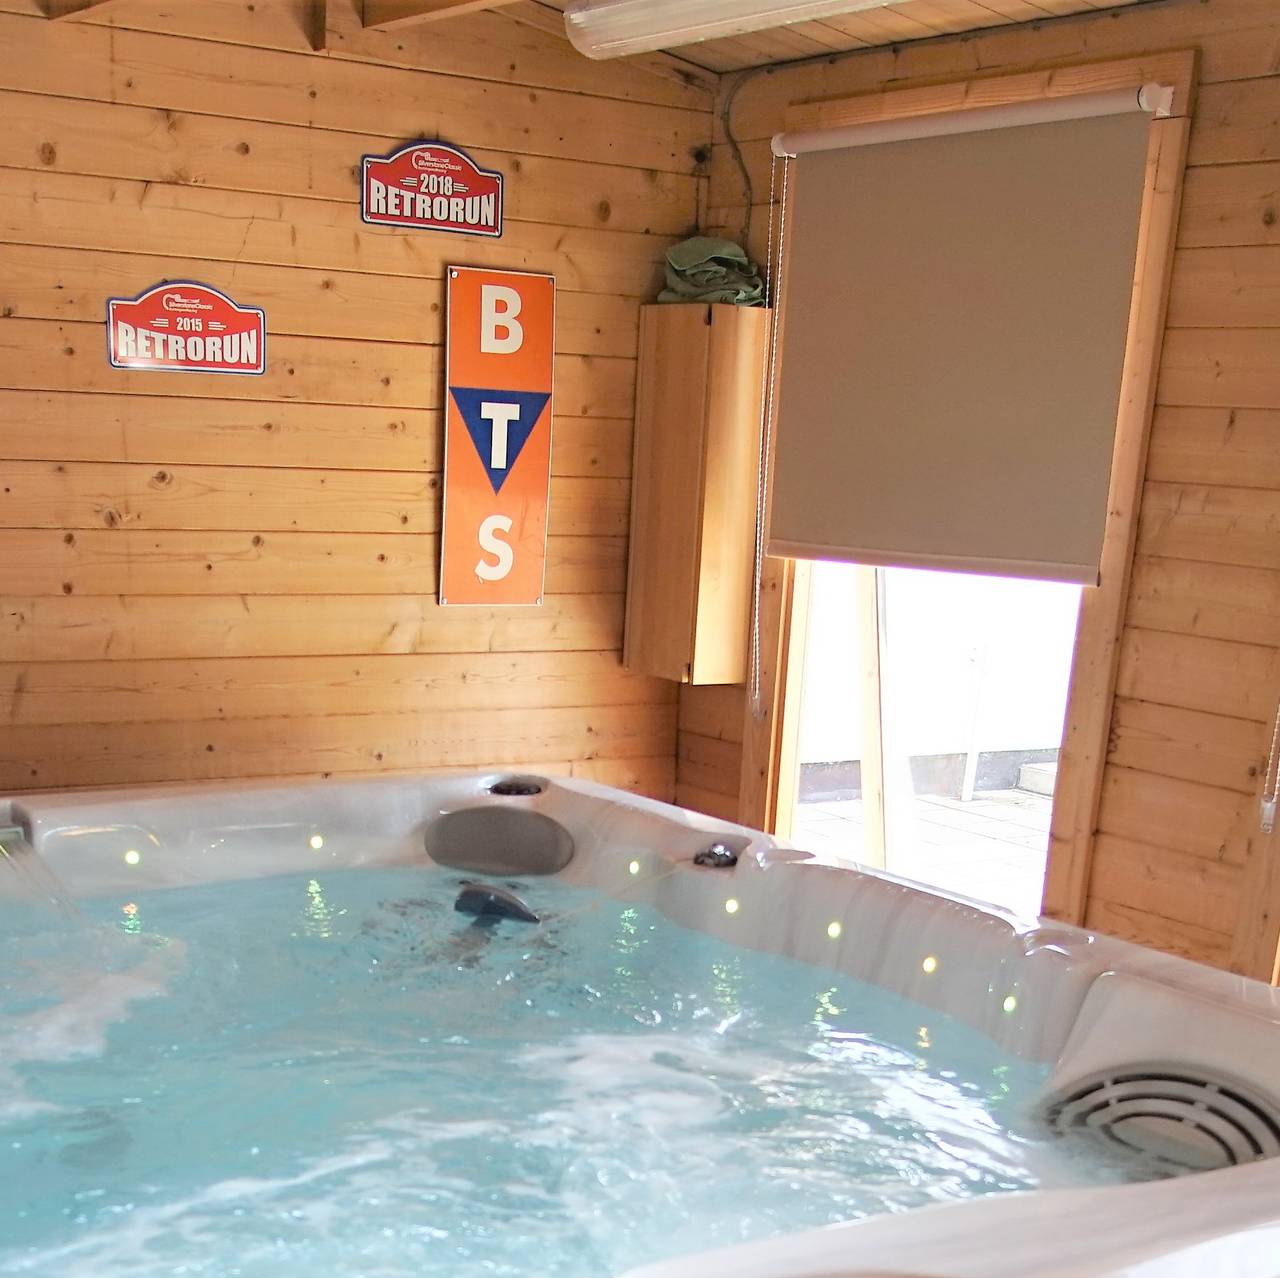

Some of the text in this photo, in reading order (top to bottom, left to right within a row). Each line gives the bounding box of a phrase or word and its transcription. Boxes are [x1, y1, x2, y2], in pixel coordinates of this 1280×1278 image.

[420, 174, 453, 196] 2018
[370, 177, 496, 227] RETRORUN
[176, 316, 203, 332] 2015
[117, 320, 257, 364] RETRORUN
